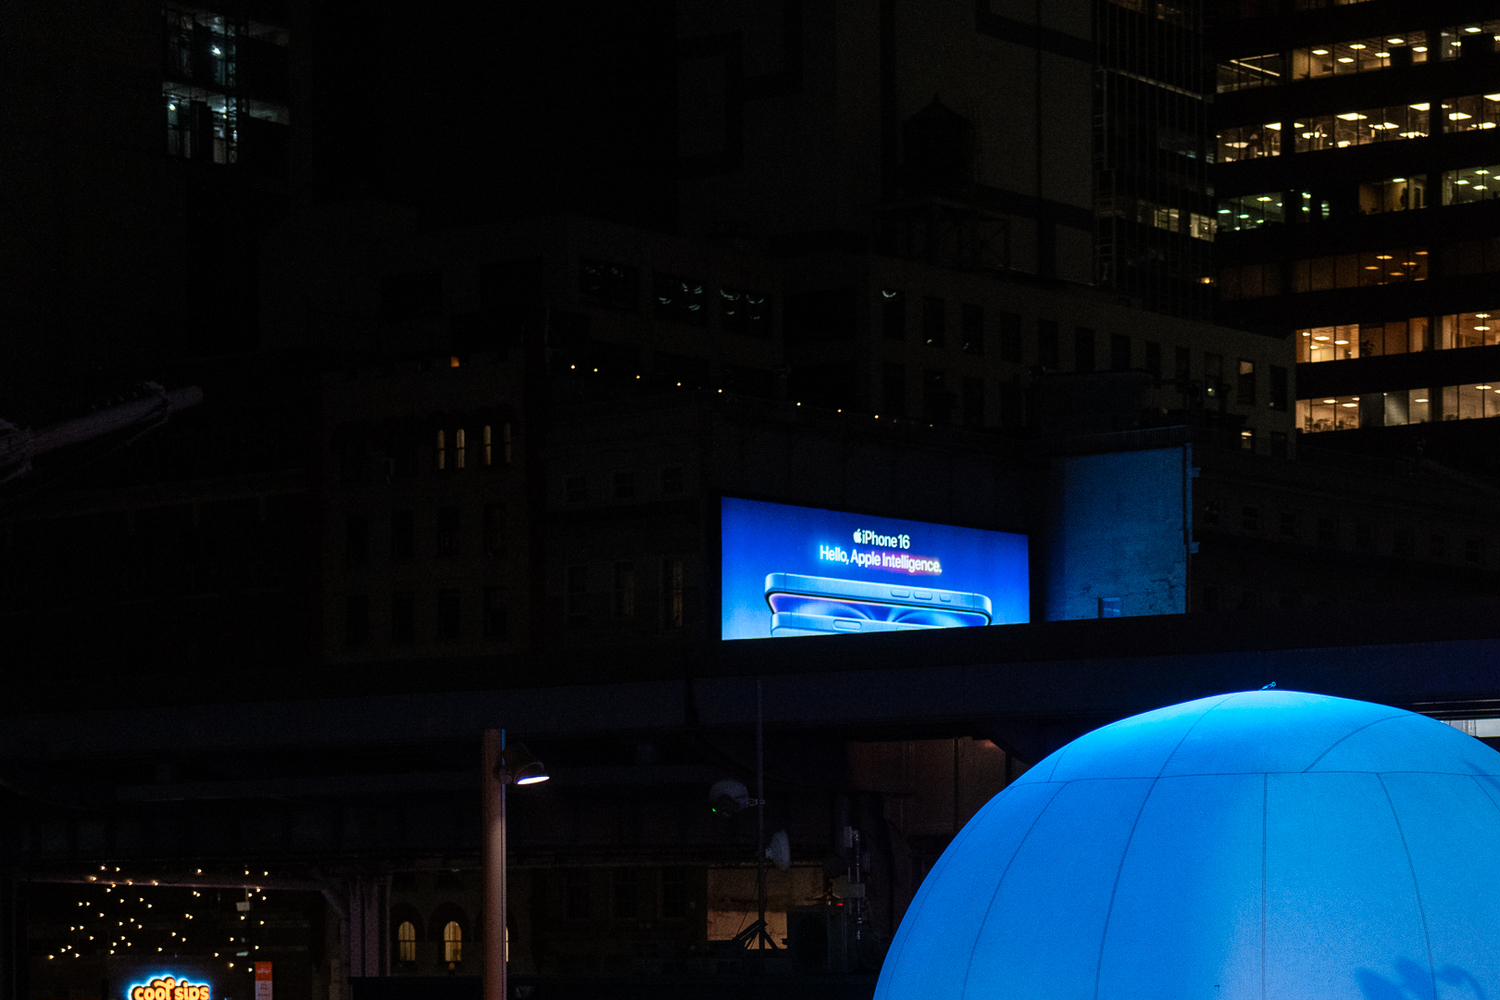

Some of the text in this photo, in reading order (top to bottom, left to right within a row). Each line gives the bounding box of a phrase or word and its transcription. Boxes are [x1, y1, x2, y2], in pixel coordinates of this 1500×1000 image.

[862, 530, 911, 550] iPhone 16
[820, 545, 942, 573] Hello, Apple Intelligence.
